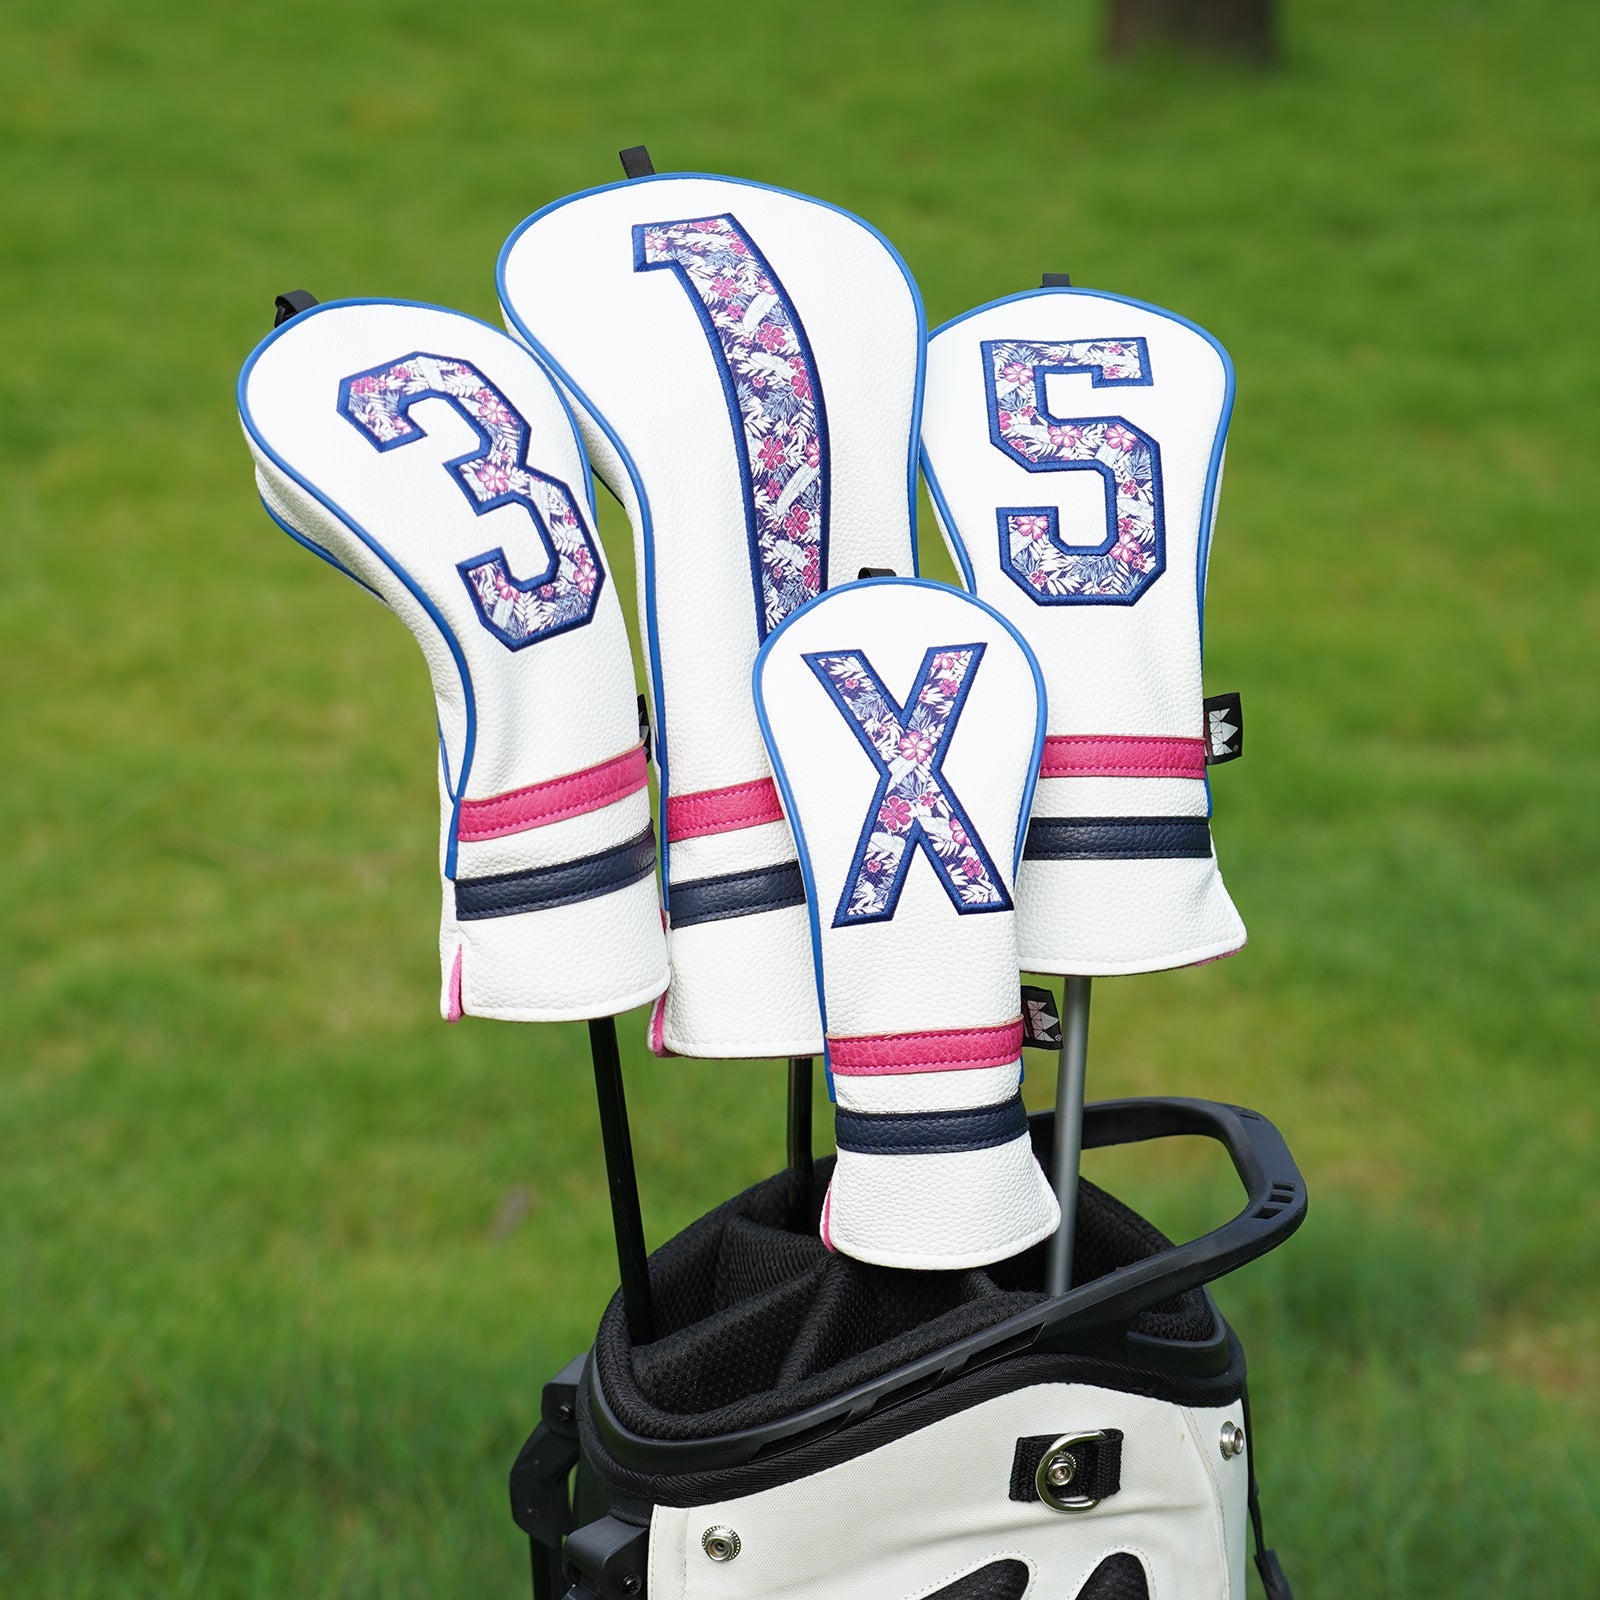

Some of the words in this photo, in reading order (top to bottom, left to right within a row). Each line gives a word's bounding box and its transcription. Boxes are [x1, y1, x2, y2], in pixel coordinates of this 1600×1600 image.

[336, 351, 606, 653] 3
[632, 212, 830, 647] 1
[980, 336, 1168, 607] 5
[800, 642, 1014, 929] X
